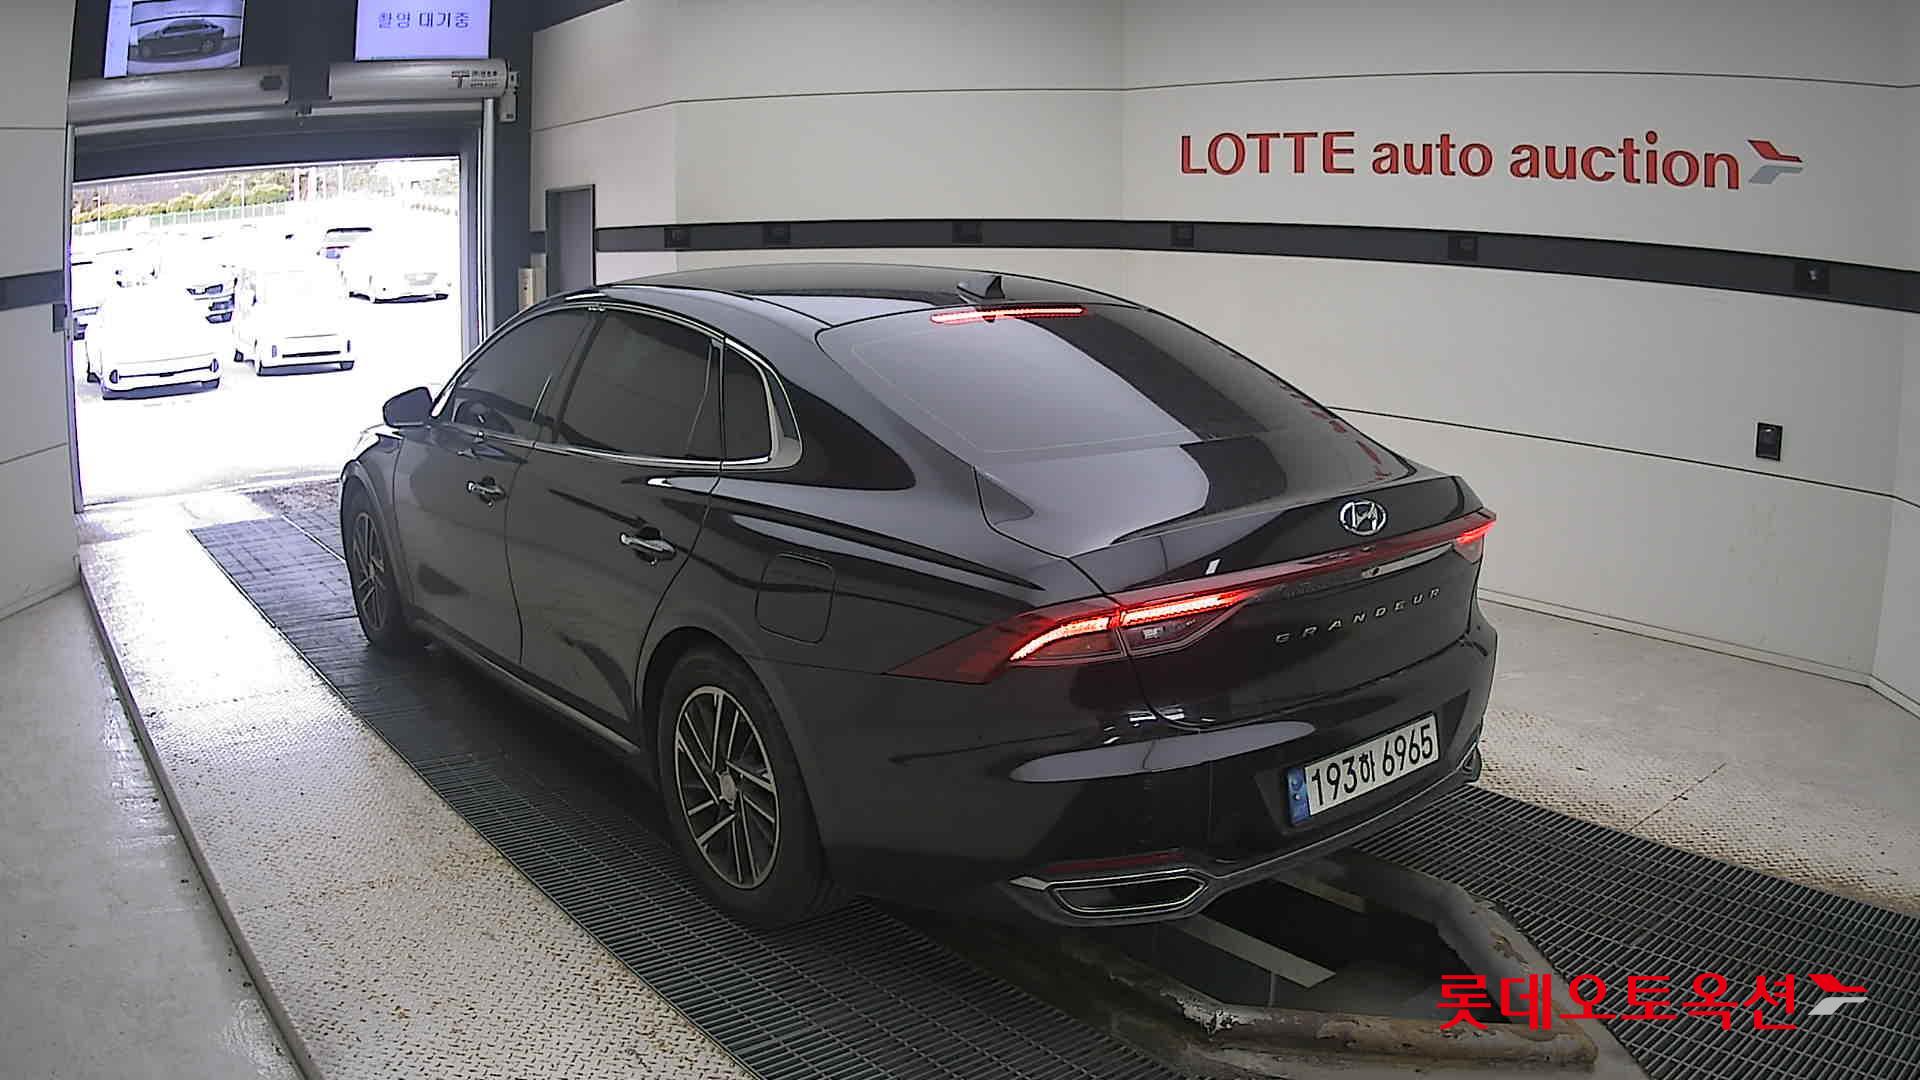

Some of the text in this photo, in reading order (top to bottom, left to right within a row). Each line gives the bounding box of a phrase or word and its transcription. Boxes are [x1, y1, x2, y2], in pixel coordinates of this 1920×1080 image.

[418, 12, 470, 29] 대기중
[1181, 130, 1739, 190] LOTTE auto auction
[1275, 588, 1440, 643] GRANDEUR
[1311, 724, 1433, 806] 193하 6965
